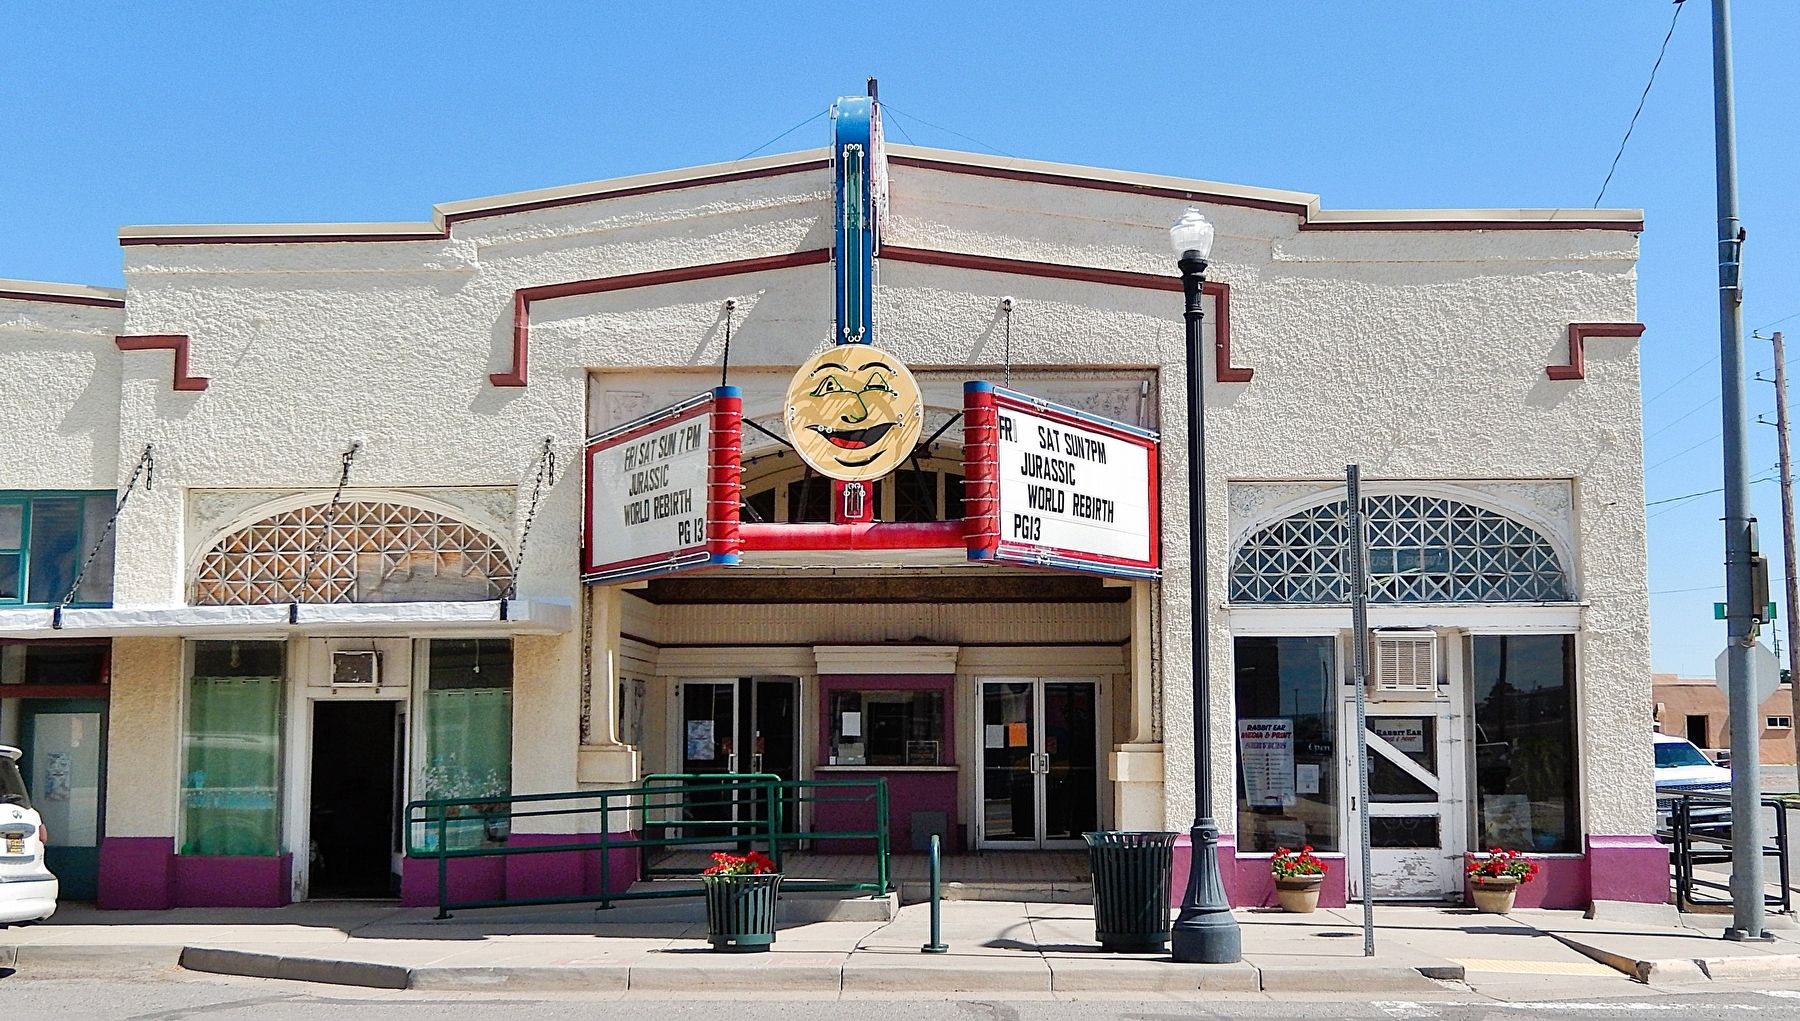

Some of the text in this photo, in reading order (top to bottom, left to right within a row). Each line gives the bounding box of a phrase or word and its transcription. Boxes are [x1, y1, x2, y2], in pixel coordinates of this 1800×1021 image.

[625, 444, 638, 472] FRI
[639, 439, 657, 465] SAT
[659, 432, 677, 459] SUN
[1038, 425, 1060, 453] SAT
[629, 464, 669, 496] JURASSIC
[1021, 452, 1076, 485] JURASSIC
[624, 488, 692, 527] WORLD REBIRTH
[1028, 484, 1114, 523] WORLD REBIRTH
